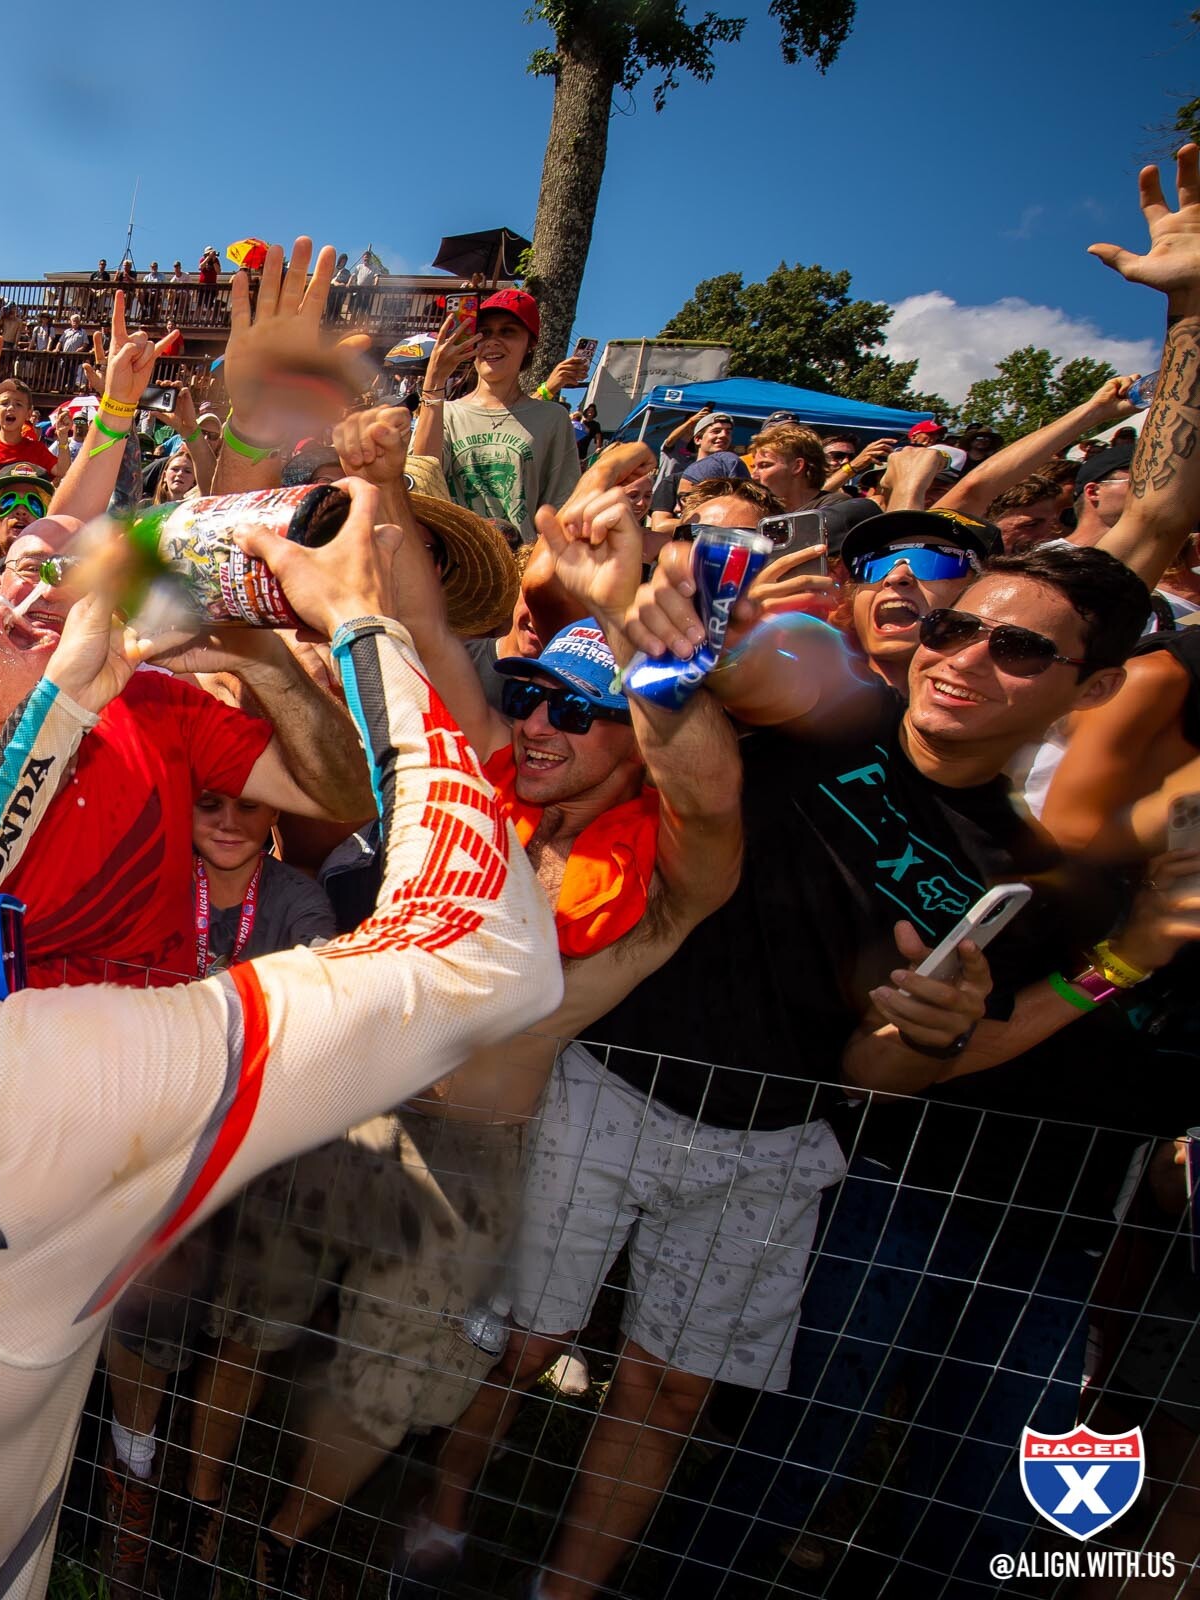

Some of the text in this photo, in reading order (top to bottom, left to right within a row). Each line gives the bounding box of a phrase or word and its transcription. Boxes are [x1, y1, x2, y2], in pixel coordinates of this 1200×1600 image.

[466, 433, 502, 446] DOESN'T
[502, 433, 521, 447] LIVE
[219, 563, 241, 617] LUCAS OIL
[836, 762, 924, 882] FX
[199, 887, 209, 916] LUCAS
[198, 932, 207, 947] OIL
[239, 916, 251, 947] LUCAS
